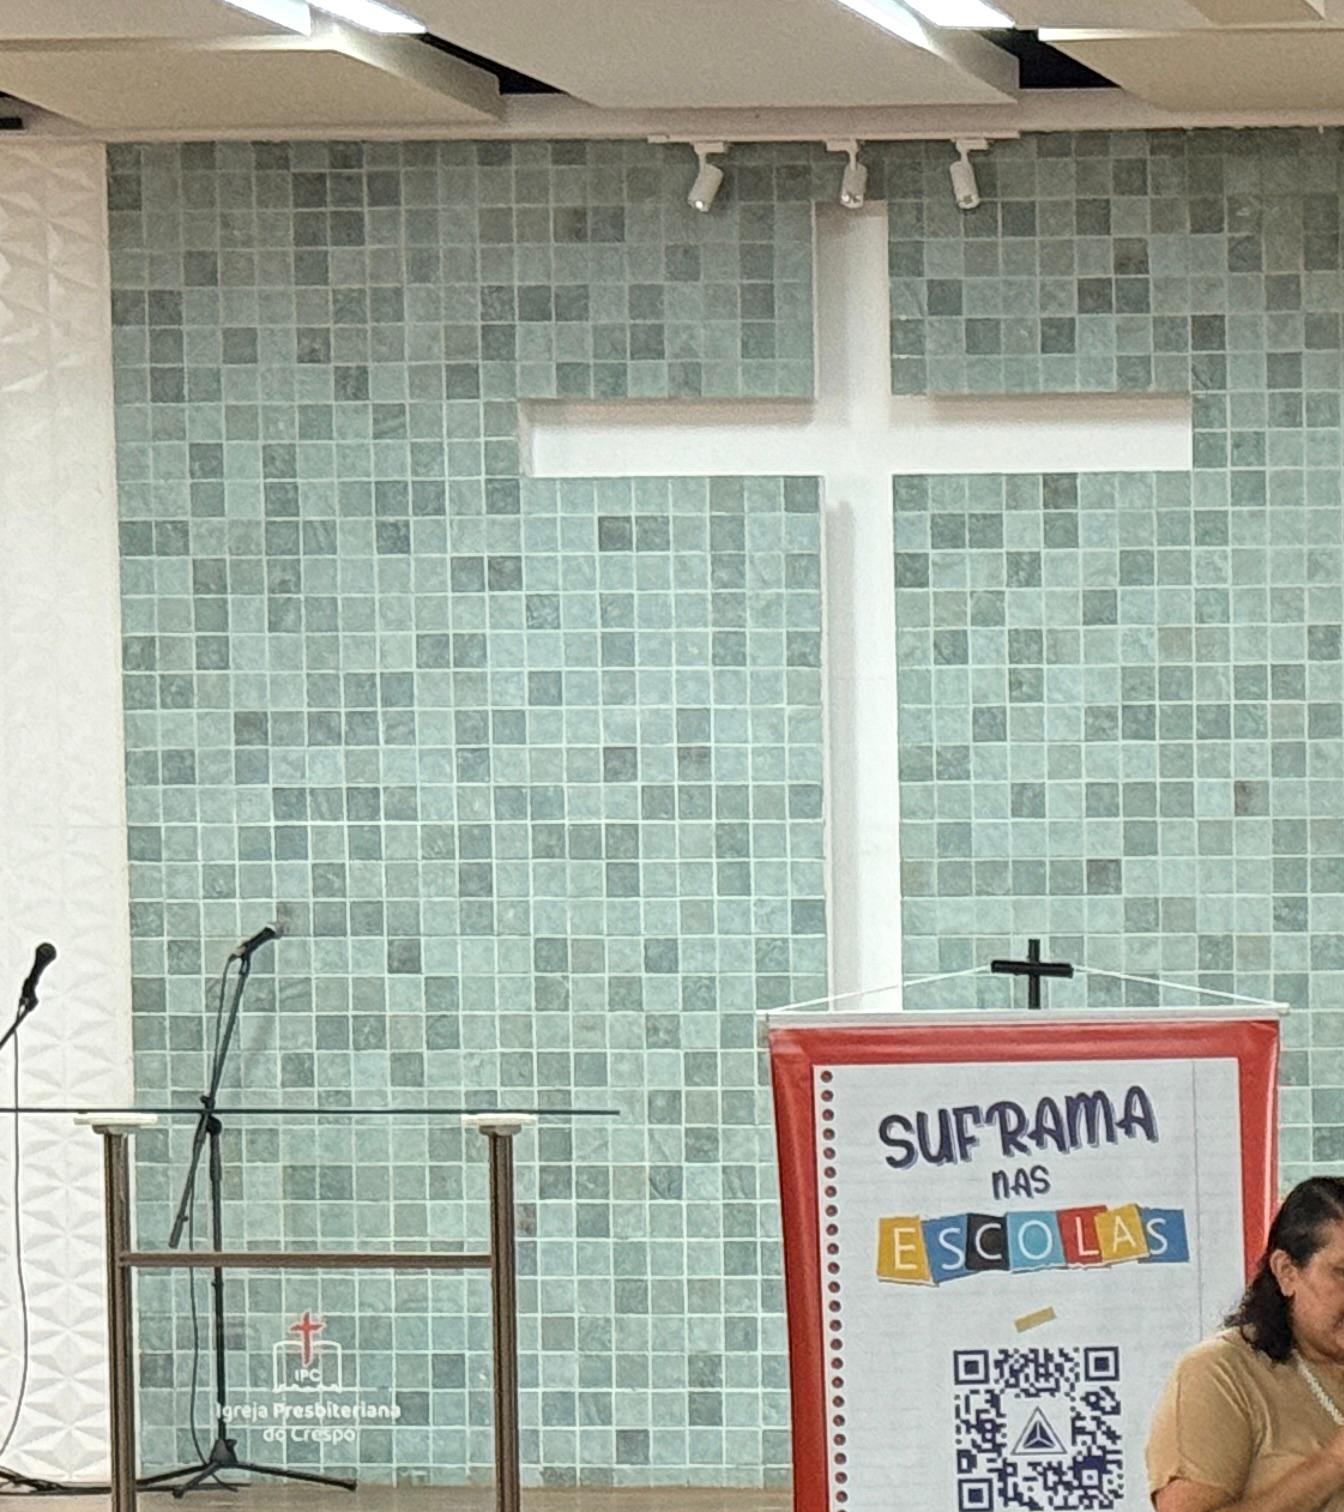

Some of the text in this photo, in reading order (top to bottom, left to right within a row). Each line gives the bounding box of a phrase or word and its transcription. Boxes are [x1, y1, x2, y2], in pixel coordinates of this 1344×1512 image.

[878, 1085, 1160, 1170] SUFRAMA
[893, 1215, 1169, 1272] ESCOLAS
[295, 1368, 321, 1383] IPC
[216, 1400, 402, 1423] Igreja Presbiteriana
[263, 1427, 356, 1445] do Crespo
